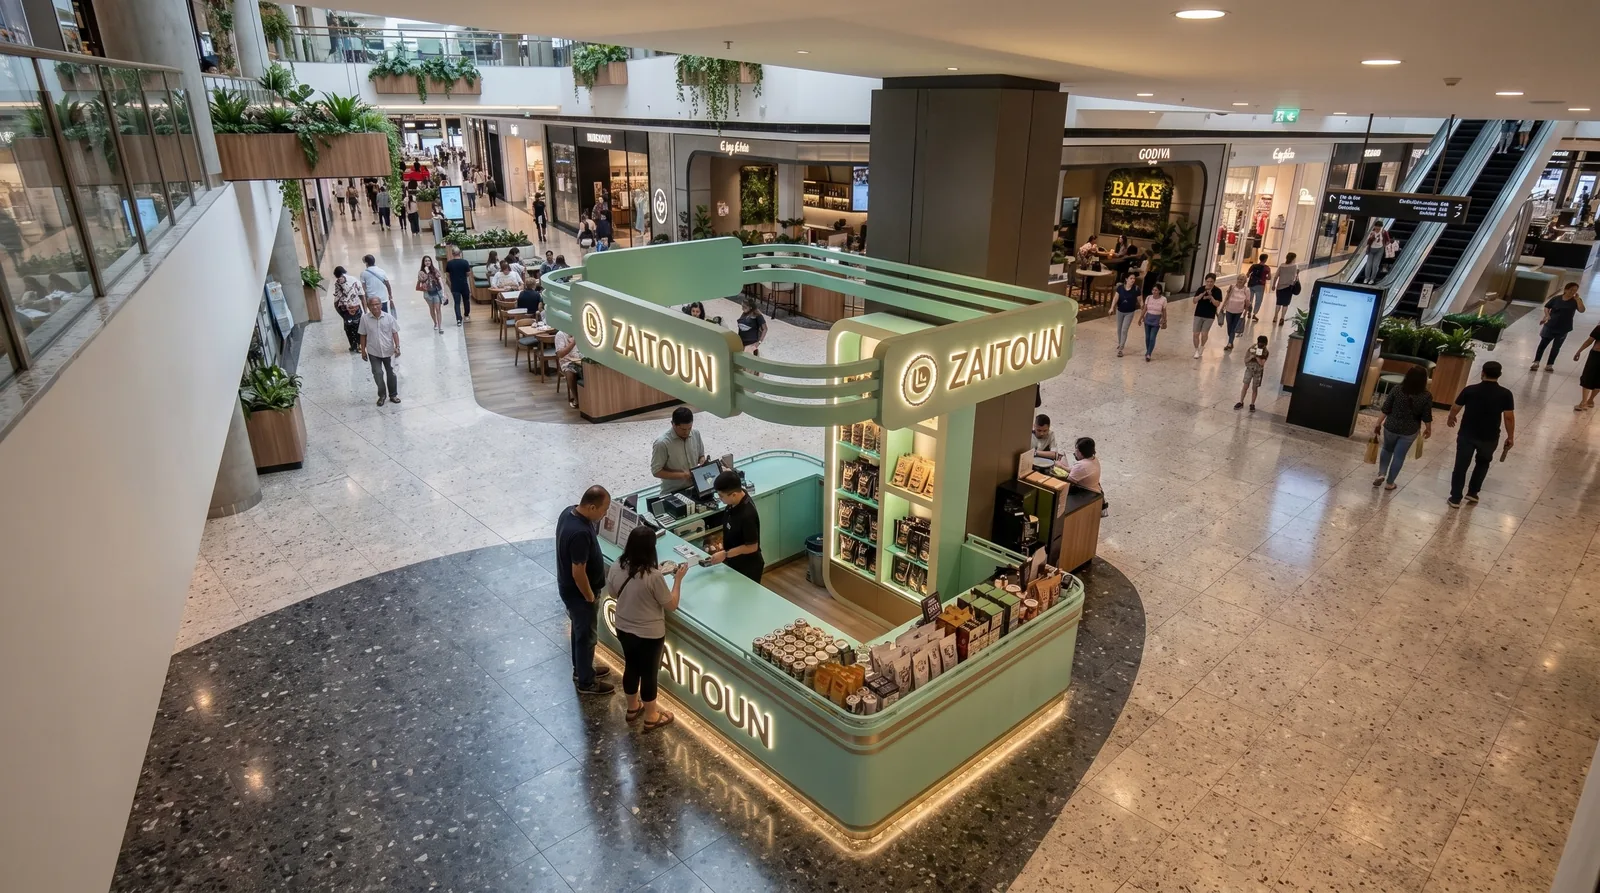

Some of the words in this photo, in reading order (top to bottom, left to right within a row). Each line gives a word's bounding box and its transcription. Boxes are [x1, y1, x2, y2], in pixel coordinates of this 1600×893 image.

[1138, 147, 1171, 160] GODIVA
[1111, 180, 1163, 201] BAKE
[611, 318, 717, 393] ZAITOUN
[946, 324, 1064, 391] ZAITOUN
[659, 641, 773, 750] AITOUN
